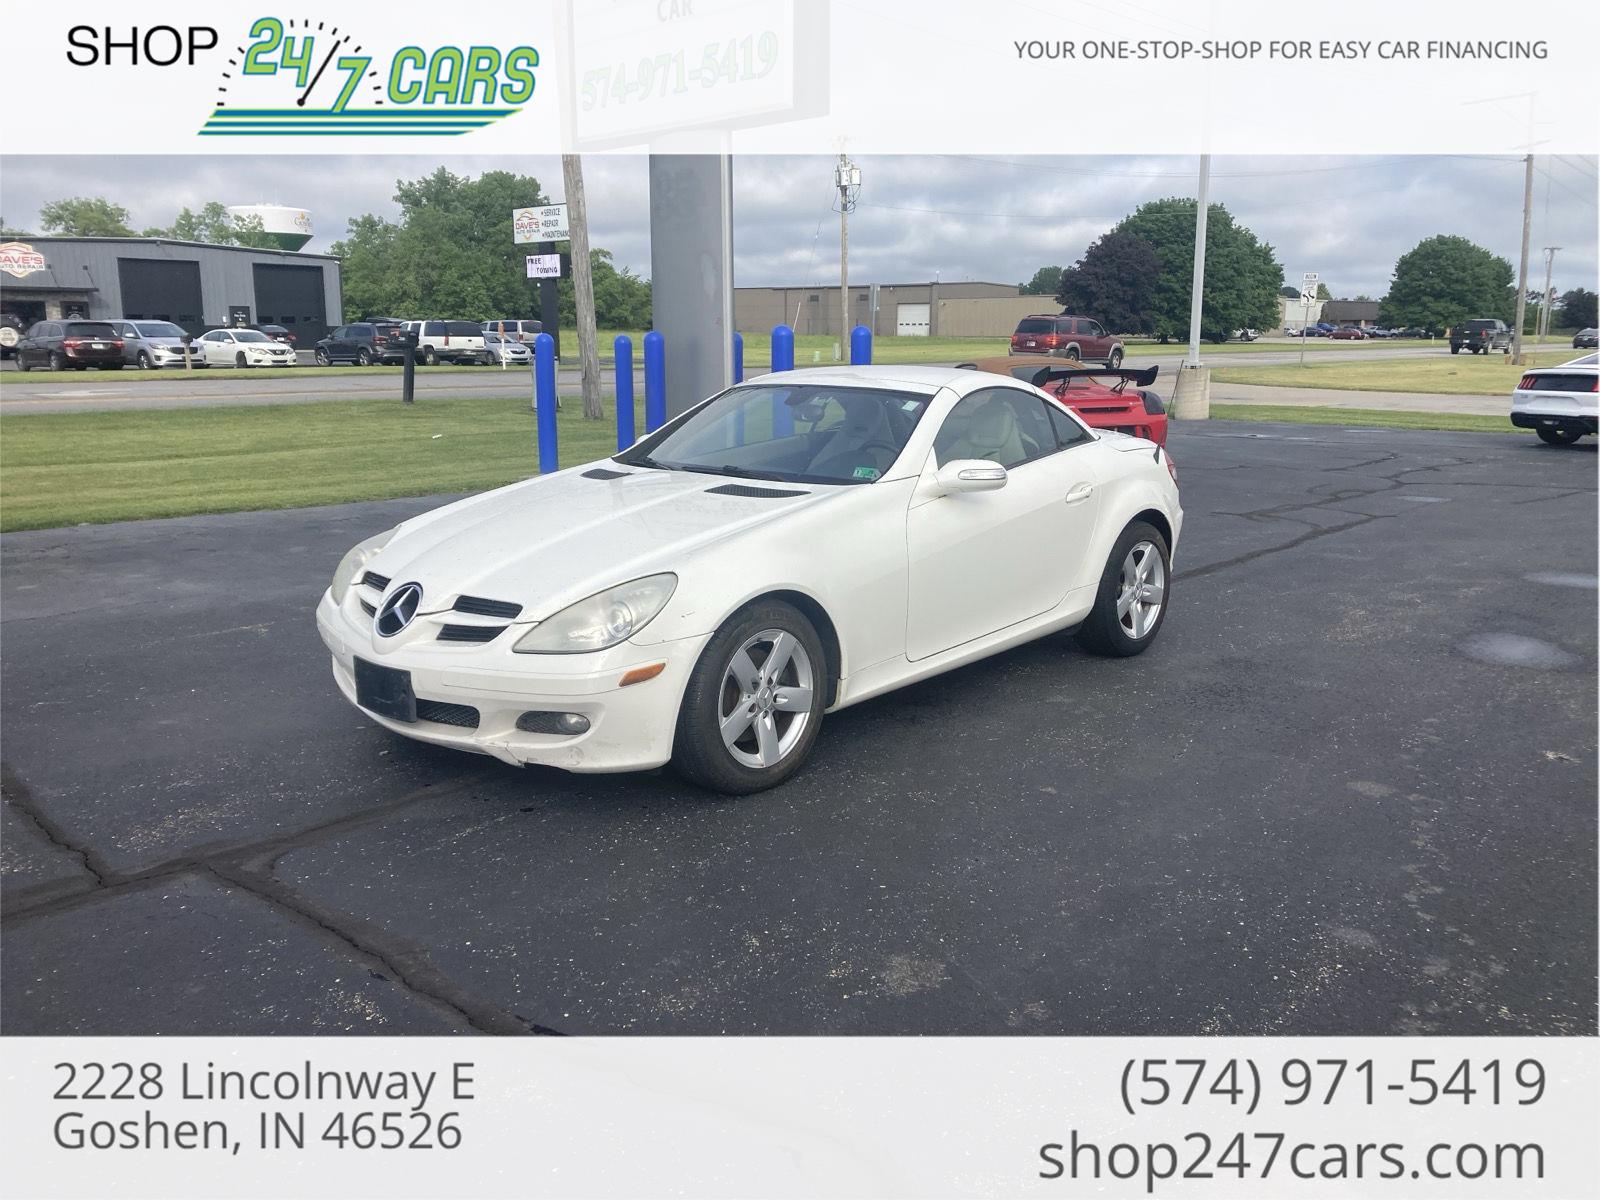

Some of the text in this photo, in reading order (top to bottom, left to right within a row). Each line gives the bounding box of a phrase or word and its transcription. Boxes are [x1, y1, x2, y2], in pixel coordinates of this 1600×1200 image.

[581, 30, 779, 112] 574-971-5419
[544, 208, 561, 217] SERVICE
[515, 221, 540, 229] DAVE'S
[544, 219, 559, 228] REPAIR
